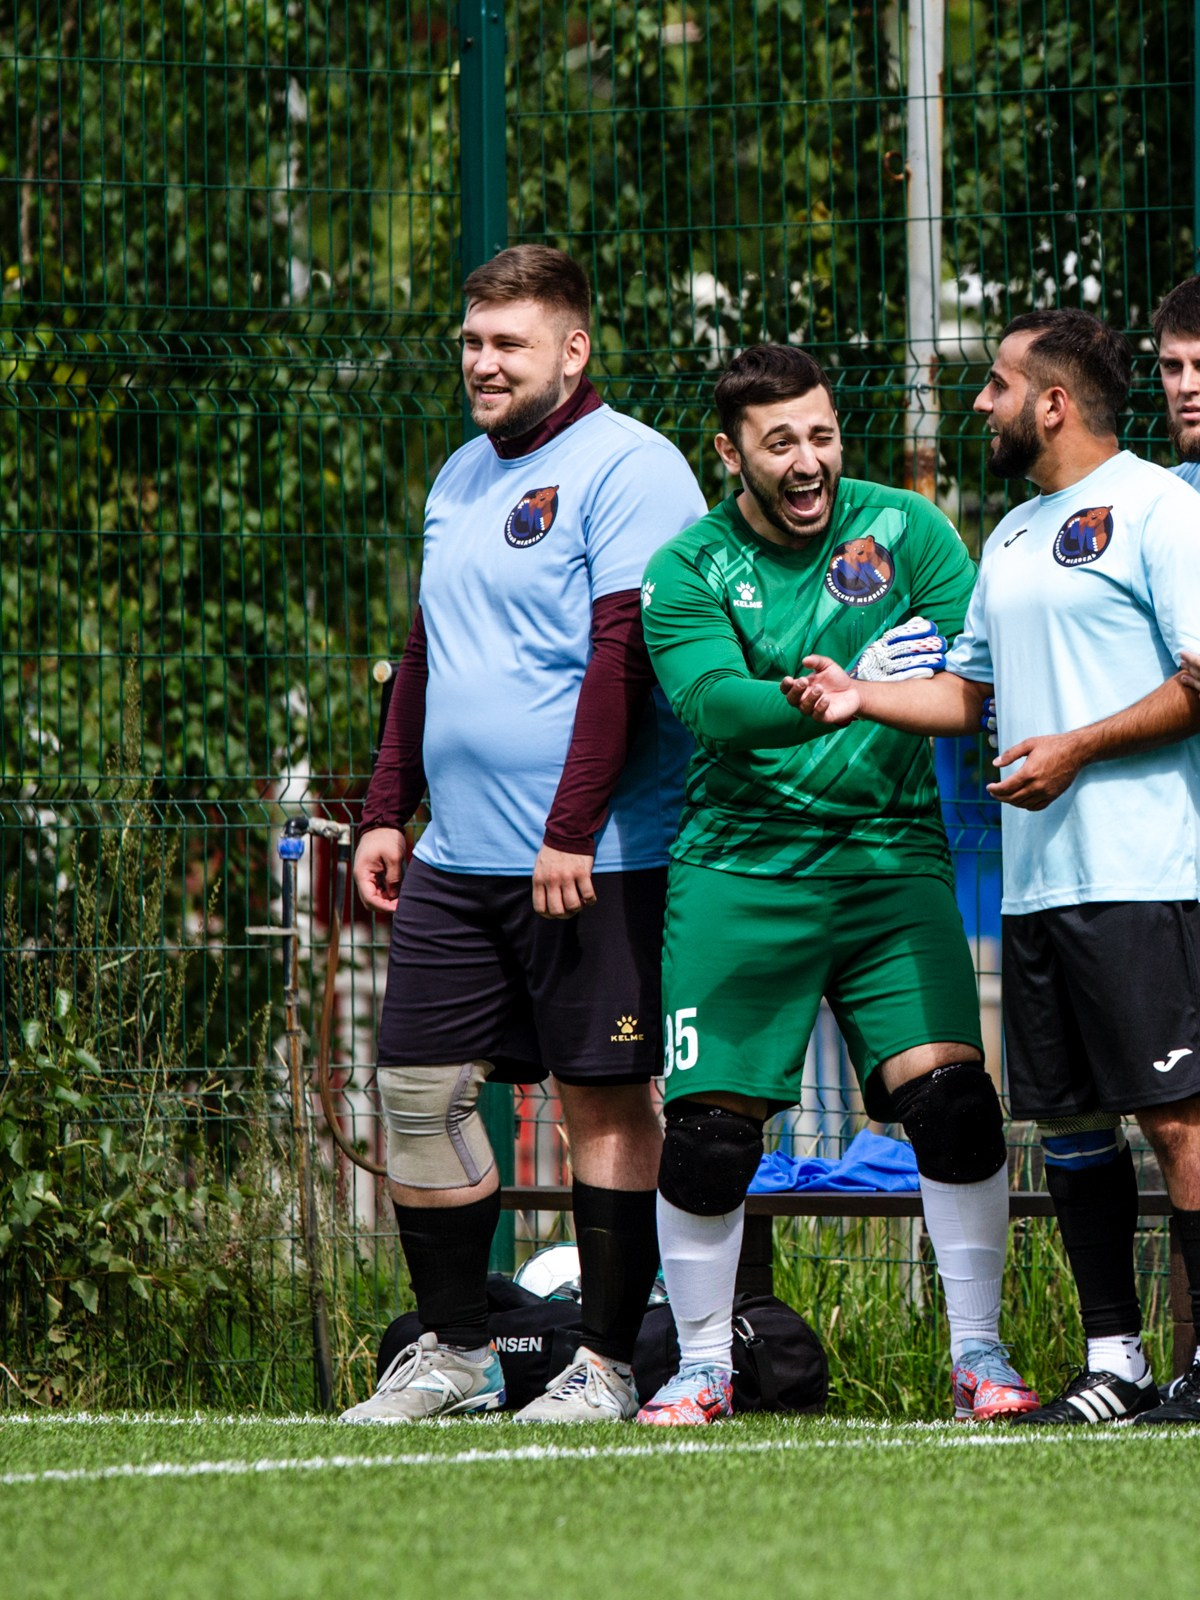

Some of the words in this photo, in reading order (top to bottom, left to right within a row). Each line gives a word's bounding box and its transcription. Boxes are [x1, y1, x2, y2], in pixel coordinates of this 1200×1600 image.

[856, 583, 888, 603] МЕДВЕДЬ
[733, 600, 763, 609] KELME
[610, 1034, 645, 1042] KELME
